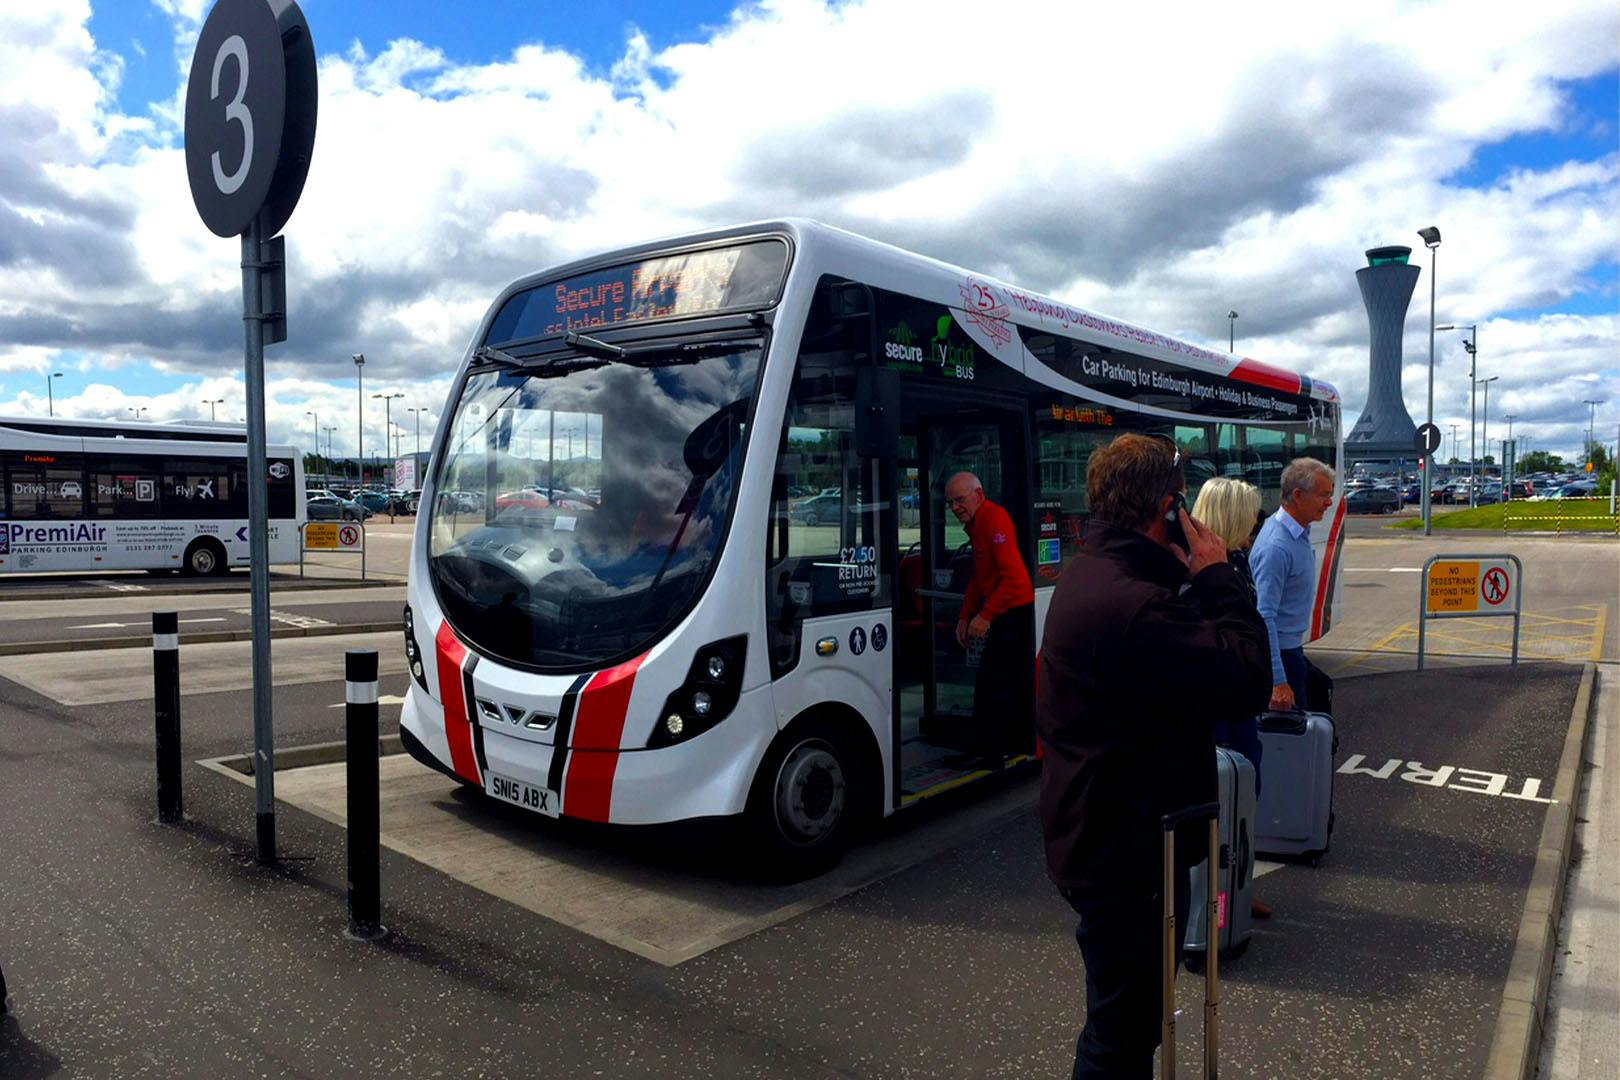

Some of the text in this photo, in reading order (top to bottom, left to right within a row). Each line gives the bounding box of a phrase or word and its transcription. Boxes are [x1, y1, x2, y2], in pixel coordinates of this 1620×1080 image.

[210, 35, 254, 194] 3
[555, 281, 625, 313] Secure
[972, 284, 995, 309] 25
[885, 341, 922, 362] secure
[955, 365, 975, 380] BUS
[1082, 355, 1100, 376] Car
[1101, 360, 1137, 387] Parking
[1138, 368, 1151, 386] for
[1152, 371, 1190, 397] Edinburgh
[1191, 380, 1215, 400] Airport
[1219, 386, 1241, 406] Holiday
[1422, 428, 1431, 449] 1
[14, 483, 57, 495] Drive...
[97, 484, 133, 496] Park...
[175, 485, 194, 498] Fly!
[11, 523, 106, 542] PremiAir
[840, 546, 876, 563] £2.50
[838, 565, 877, 580] RETURN
[1448, 567, 1459, 575] NO
[1431, 577, 1476, 586] PEDESTRIANS
[1431, 587, 1475, 596] BEYOND THIS
[1442, 598, 1463, 606] POINT
[493, 777, 548, 811] SN15 ABX
